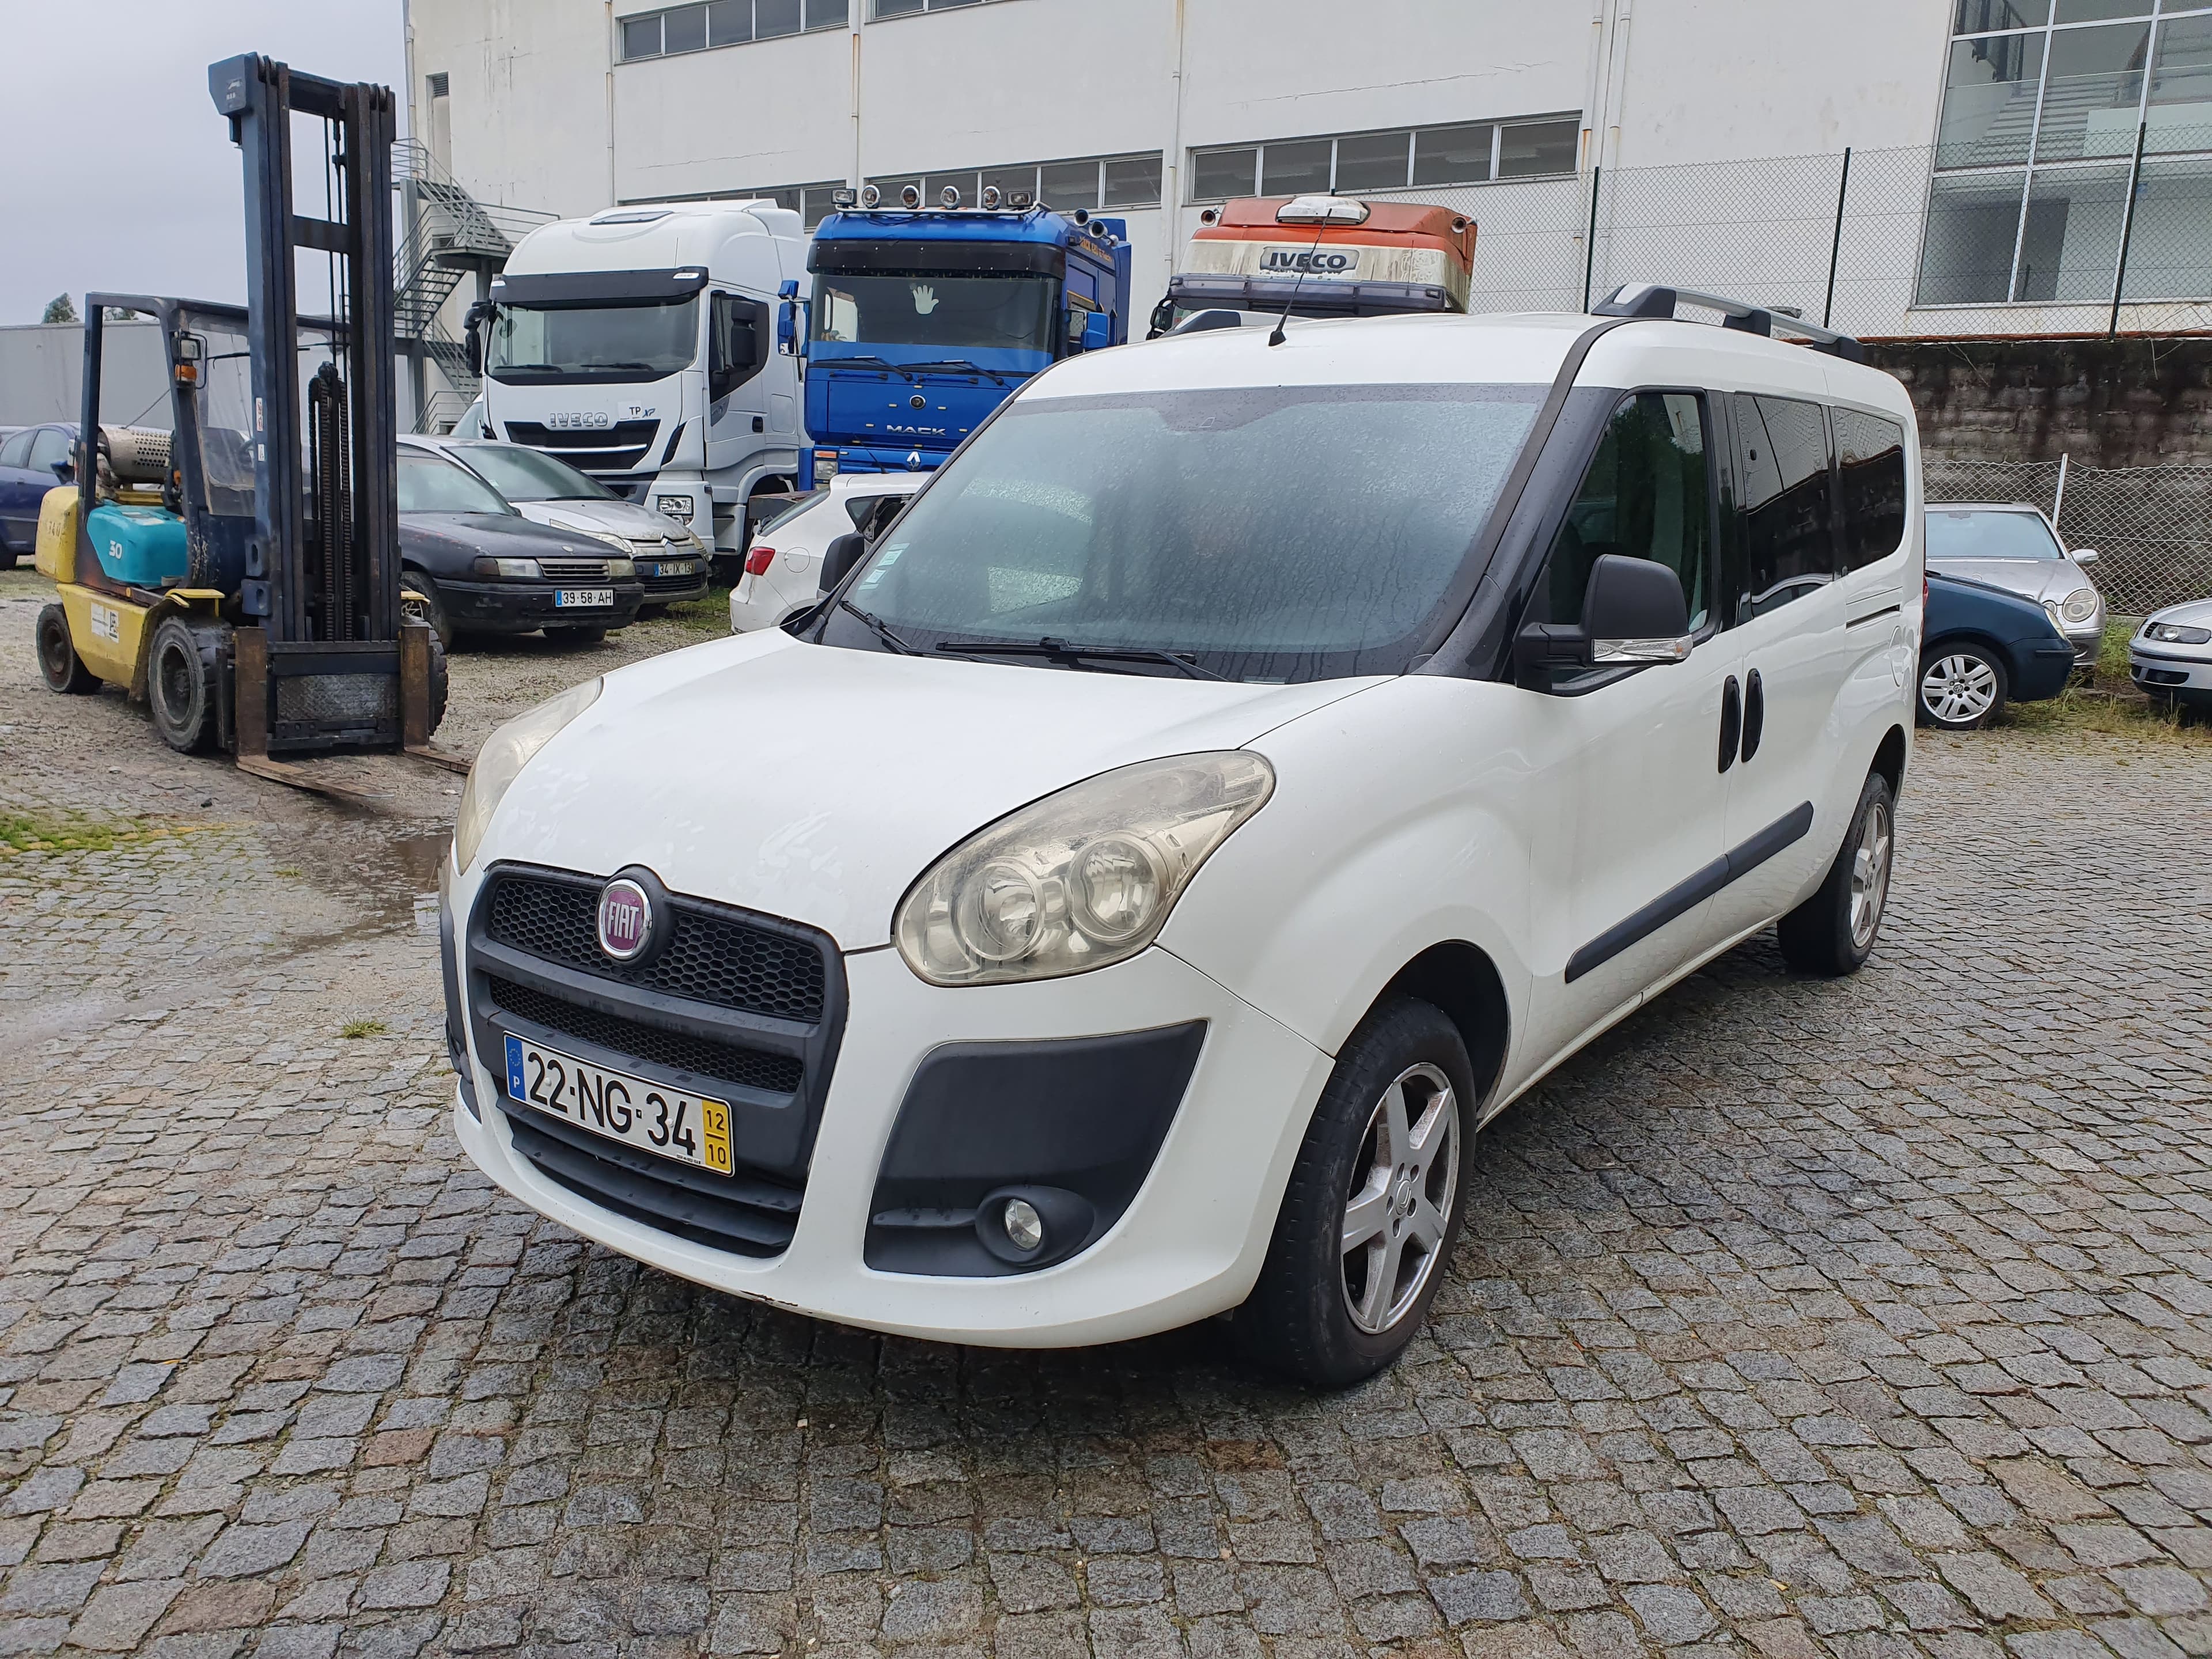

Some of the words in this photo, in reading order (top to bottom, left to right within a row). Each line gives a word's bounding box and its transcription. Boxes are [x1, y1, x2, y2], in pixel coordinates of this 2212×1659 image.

[1270, 252, 1347, 269] IVECO
[629, 406, 641, 415] TP
[642, 408, 656, 418] XP
[550, 412, 608, 427] IVECO
[887, 425, 946, 436] MACK
[109, 540, 122, 559] 30
[607, 901, 640, 941] FIAT
[513, 1075, 520, 1089] P
[706, 1109, 725, 1131] 12
[709, 1143, 726, 1164] 10
